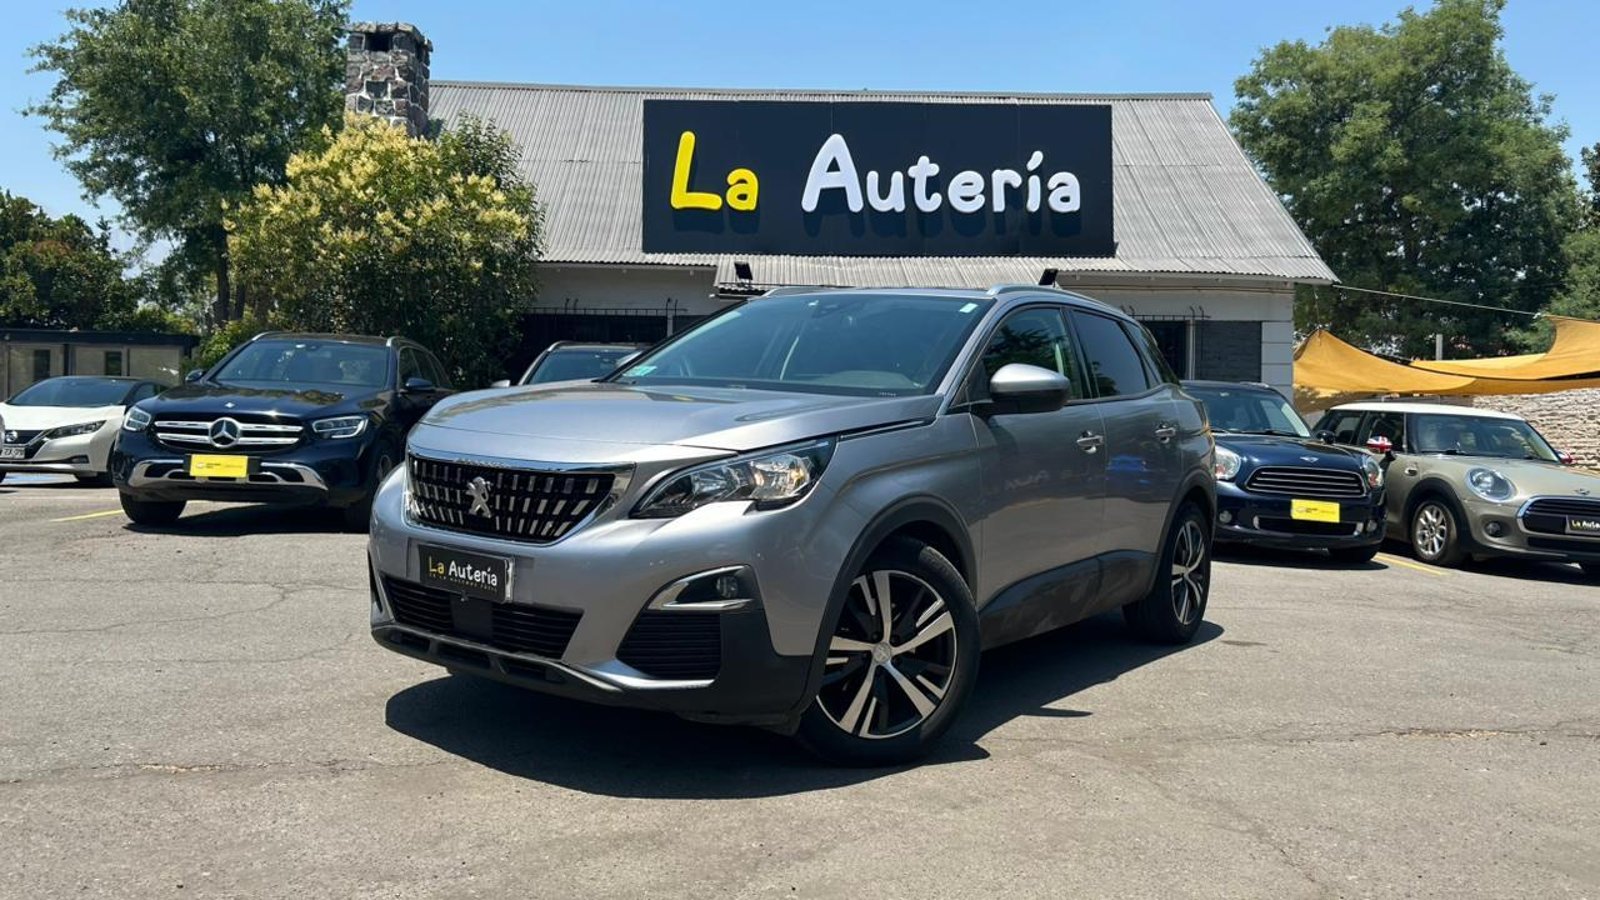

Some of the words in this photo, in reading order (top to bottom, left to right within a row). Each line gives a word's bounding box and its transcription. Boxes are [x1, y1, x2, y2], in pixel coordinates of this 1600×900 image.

[670, 131, 760, 211] La
[801, 133, 1081, 213] Autería
[428, 556, 445, 574] La
[448, 560, 497, 587] Autería
